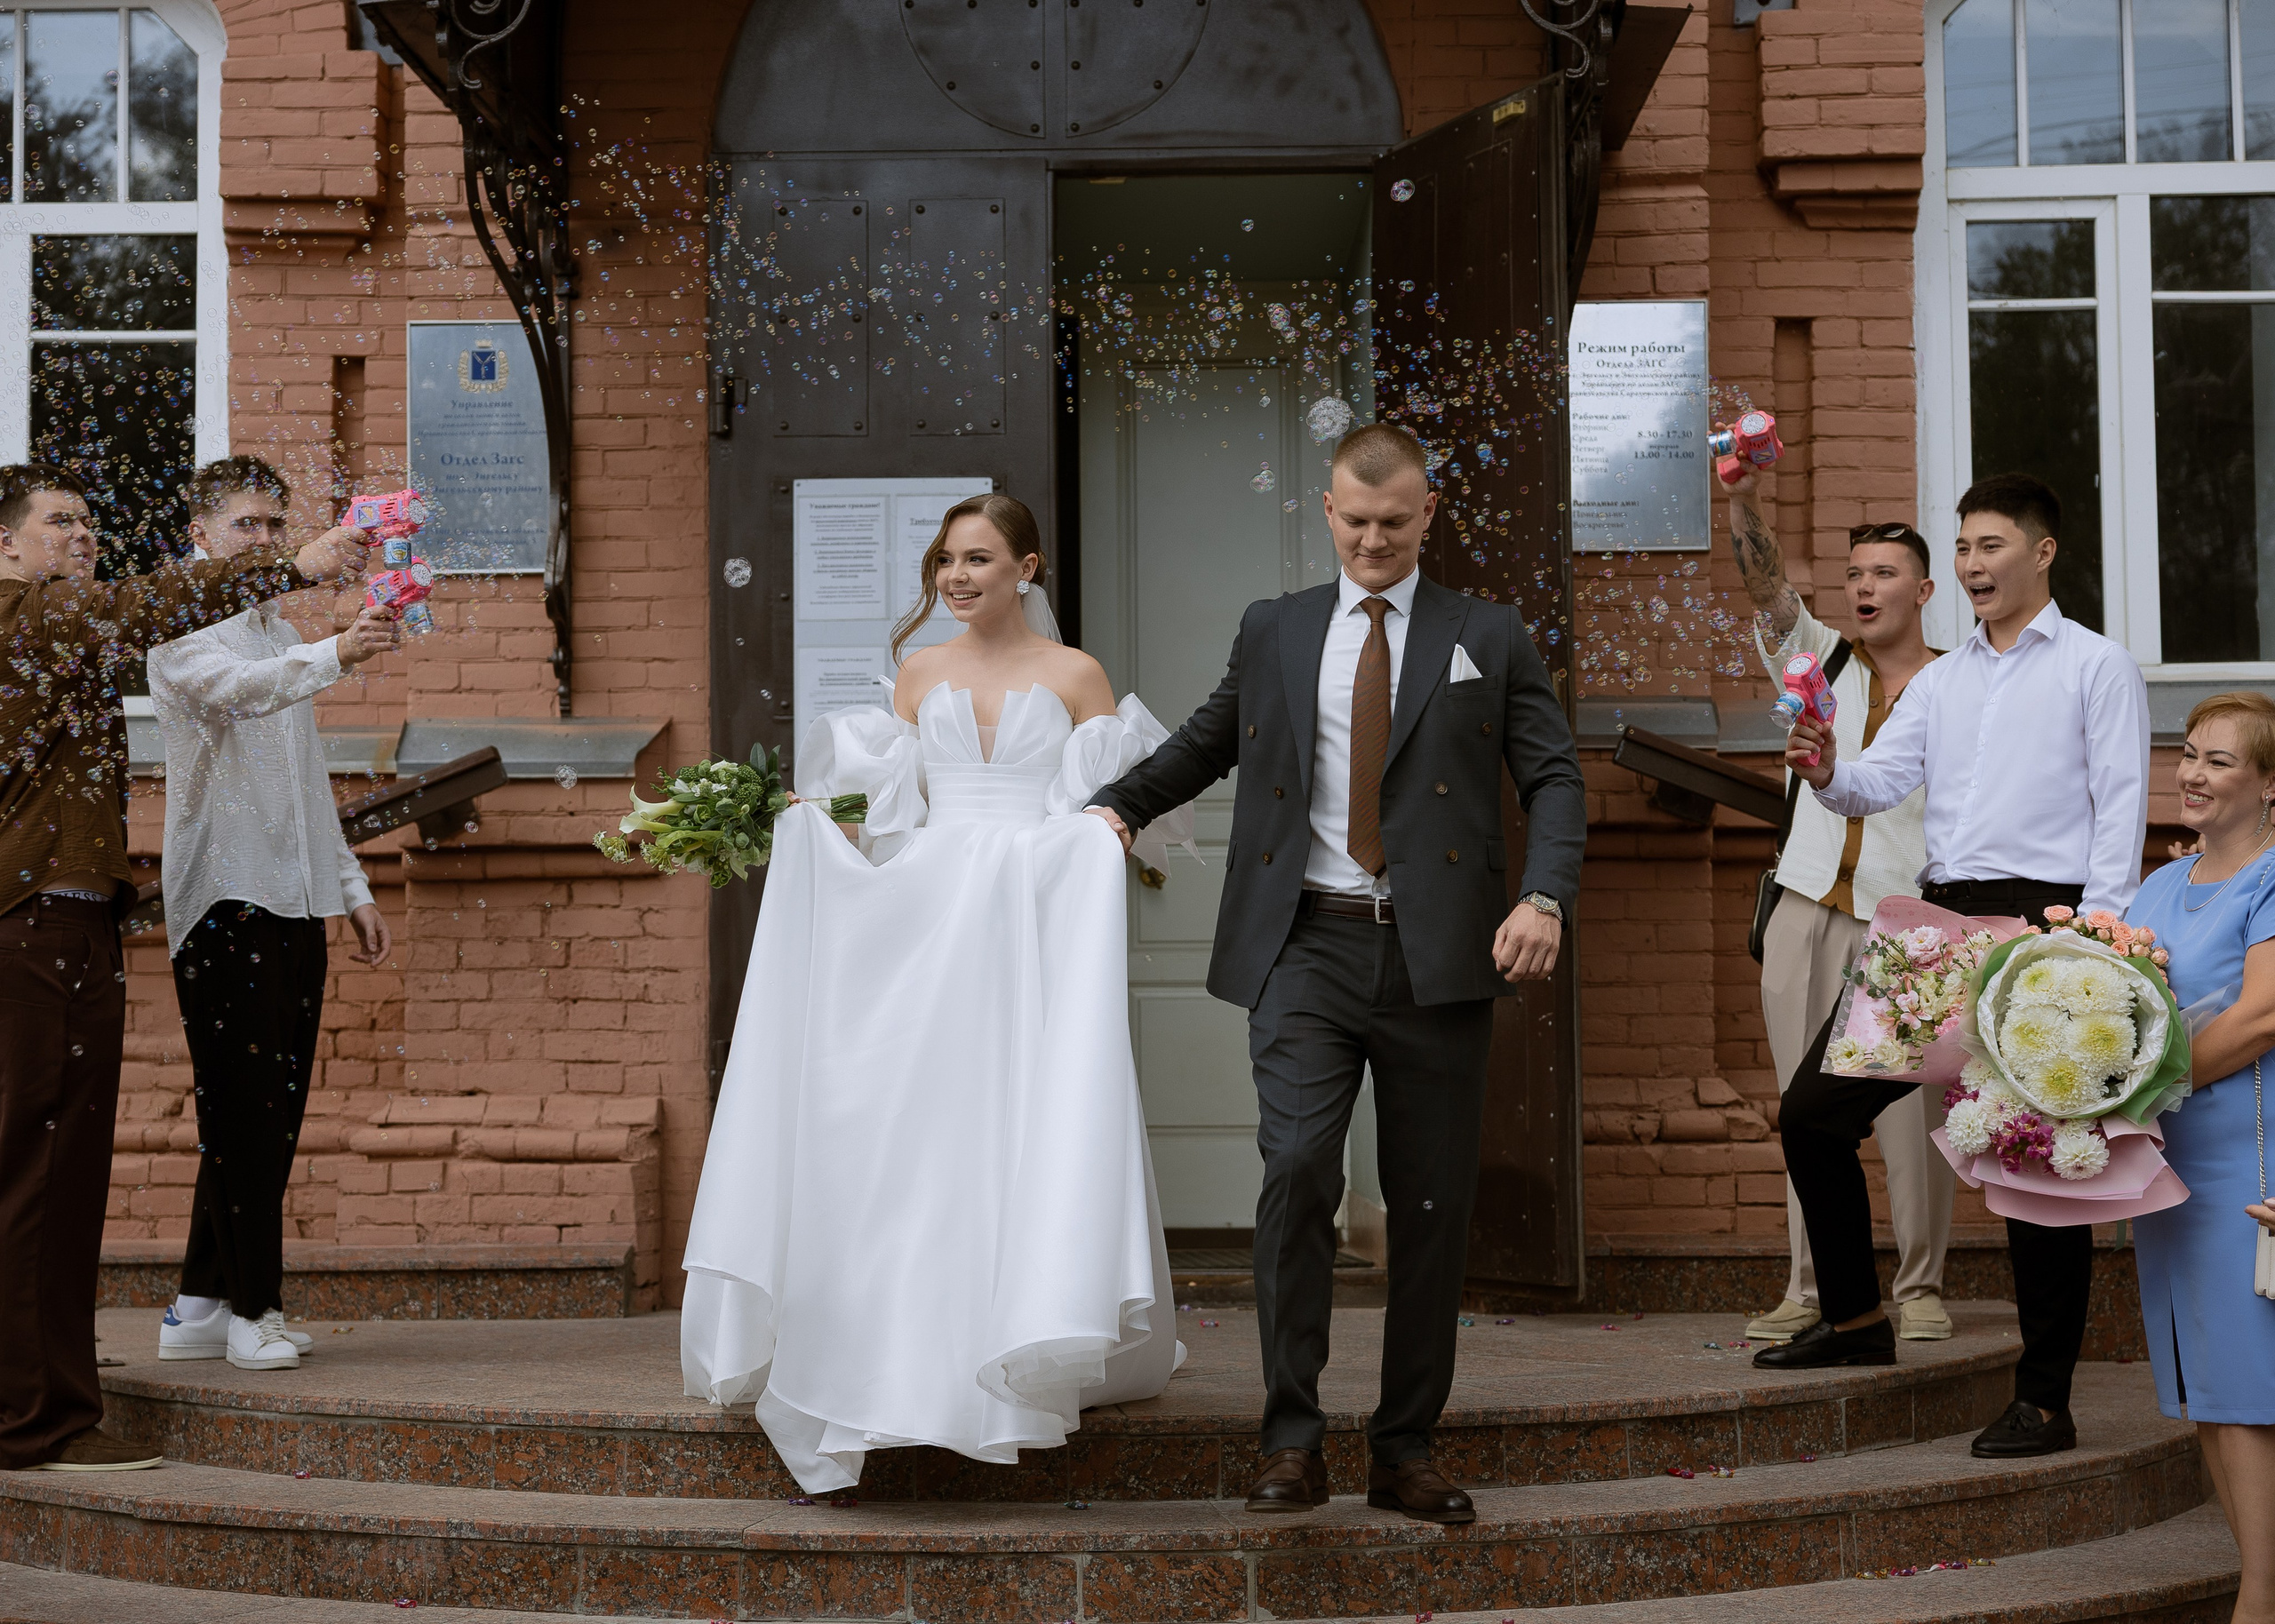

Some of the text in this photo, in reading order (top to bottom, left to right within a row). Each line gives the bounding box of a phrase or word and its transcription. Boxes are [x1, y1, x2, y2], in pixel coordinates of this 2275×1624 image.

[1577, 341, 1685, 356] Режим работы
[1596, 359, 1667, 369] Отдела ЗАГС
[451, 400, 514, 410] Управление
[1572, 434, 1598, 442] Среда
[1637, 430, 1658, 439] 8.30
[1666, 430, 1693, 439] 17.30
[1572, 445, 1605, 454] Четверг
[440, 451, 524, 467] Отдел Загс
[1634, 450, 1661, 459] 13.00
[1668, 450, 1695, 459] 14.00
[1572, 455, 1609, 464] Пятница
[1572, 466, 1608, 474] Суббота
